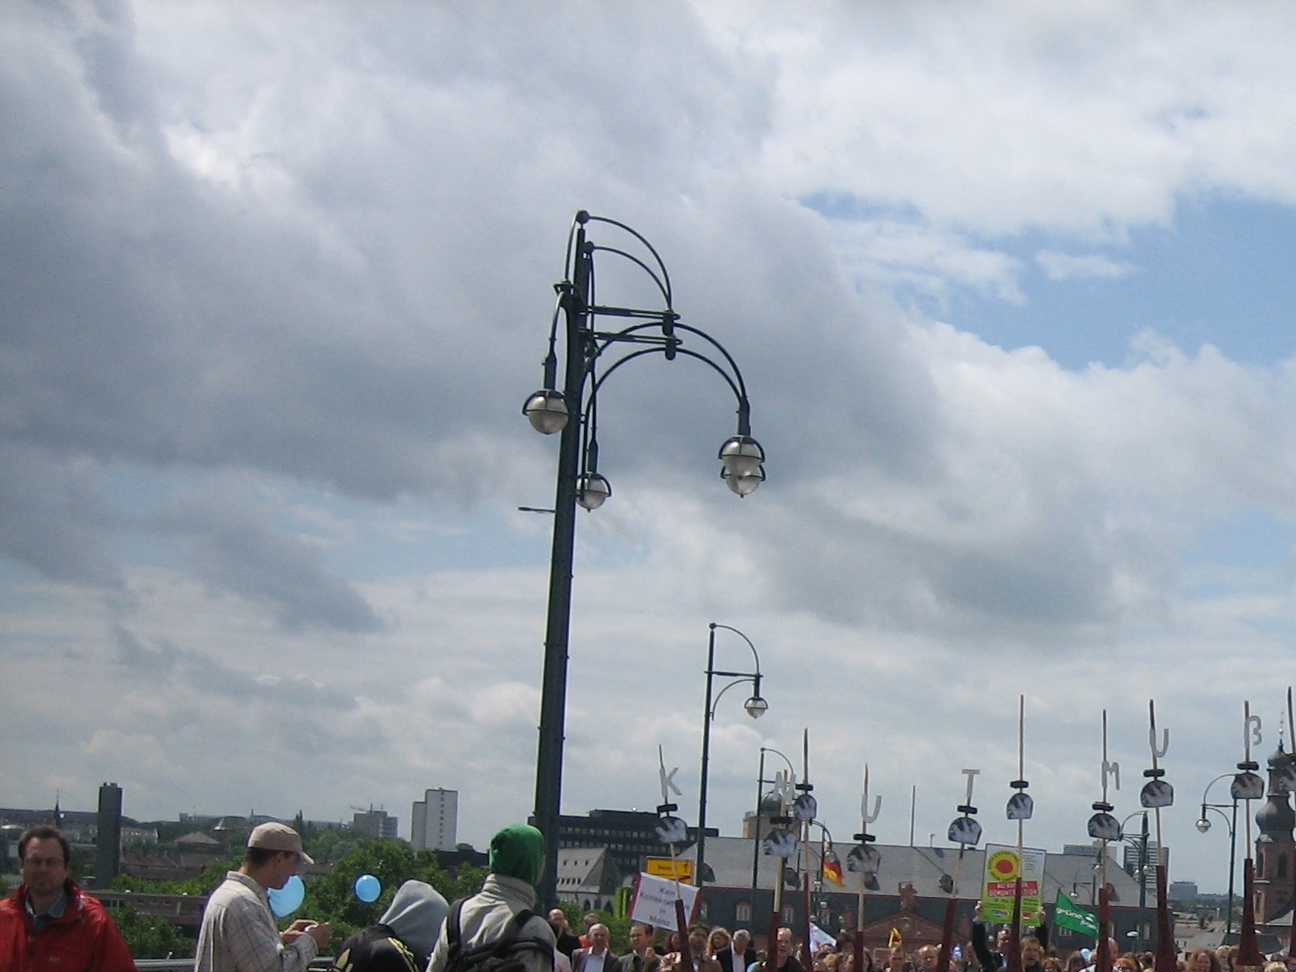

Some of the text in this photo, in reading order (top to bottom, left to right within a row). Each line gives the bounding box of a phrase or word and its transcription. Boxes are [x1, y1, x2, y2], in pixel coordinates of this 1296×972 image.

[1149, 727, 1170, 758] U
[658, 765, 683, 797] K
[961, 768, 981, 800] T
[1101, 760, 1121, 791] M
[860, 793, 882, 824] U
